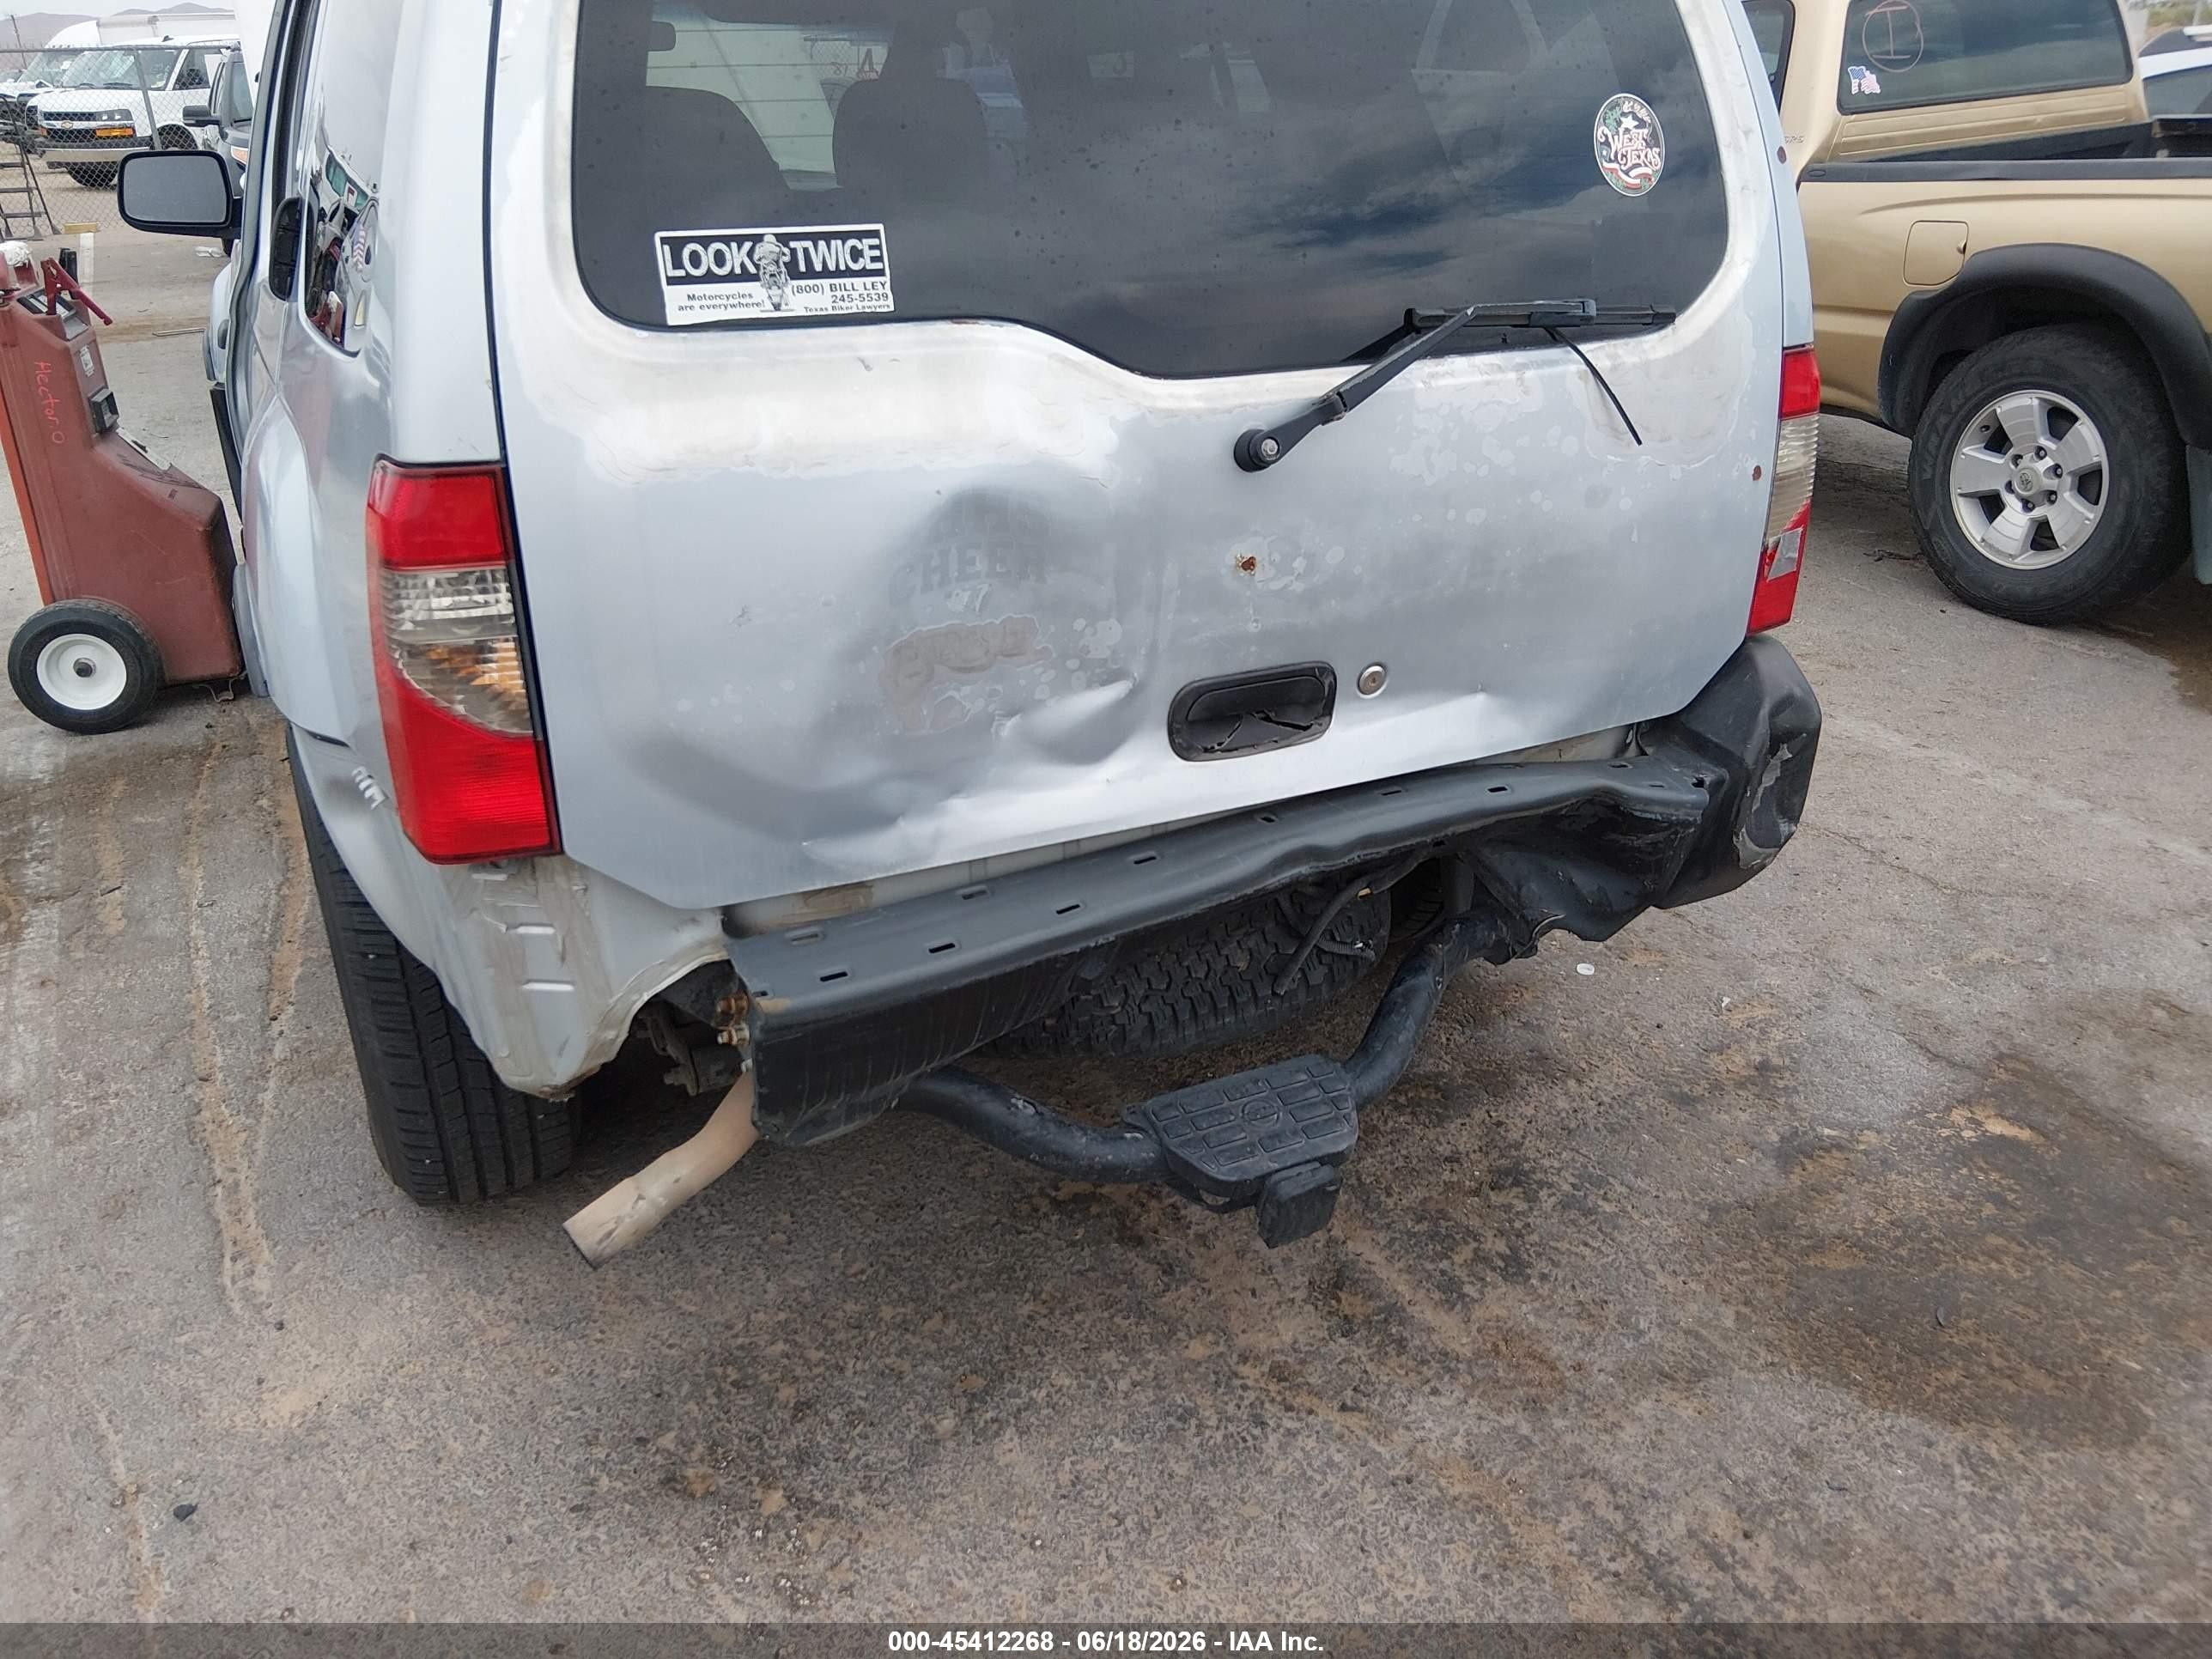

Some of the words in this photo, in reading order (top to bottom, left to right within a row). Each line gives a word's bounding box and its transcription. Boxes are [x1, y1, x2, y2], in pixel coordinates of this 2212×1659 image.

[1597, 126, 1649, 161] WEST
[1618, 145, 1661, 172] TEXAS
[662, 240, 757, 277] LOOK
[789, 237, 884, 273] TWICE
[791, 283, 824, 296] (800)
[830, 282, 859, 293] BILL
[863, 281, 887, 291] LEY
[687, 292, 754, 302] Motorcycles
[830, 292, 889, 304] 245-5539
[699, 299, 766, 312] everywhere!
[855, 303, 890, 312] Lawyers
